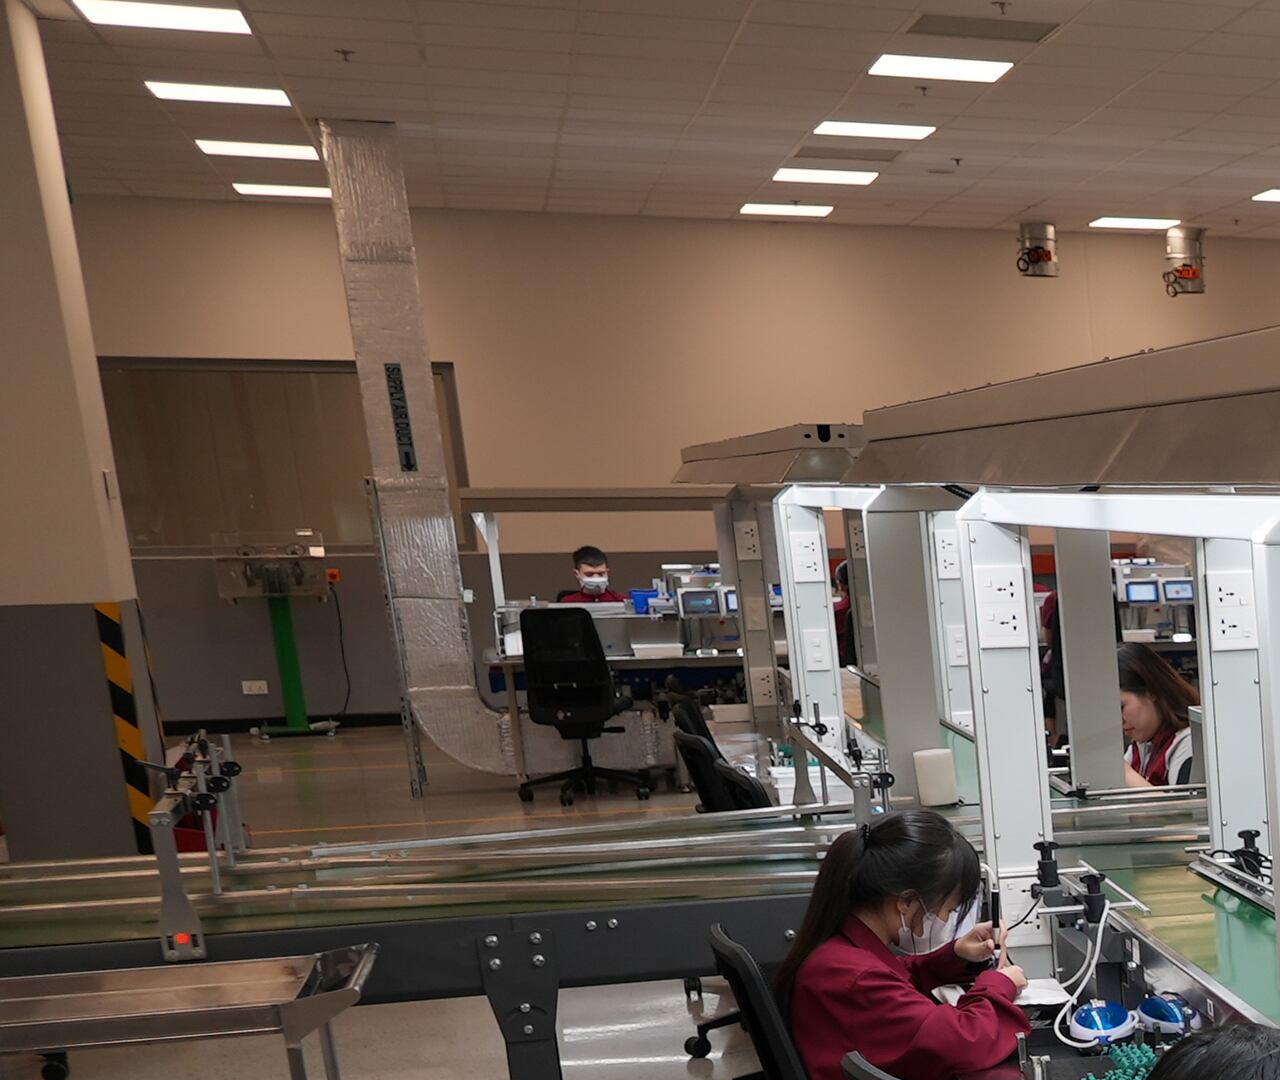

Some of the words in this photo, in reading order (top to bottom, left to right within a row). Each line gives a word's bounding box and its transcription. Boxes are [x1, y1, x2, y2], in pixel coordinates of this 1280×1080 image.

[386, 366, 404, 402] SUPPLY
[392, 404, 408, 419] AIR
[395, 422, 412, 448] DUCT
